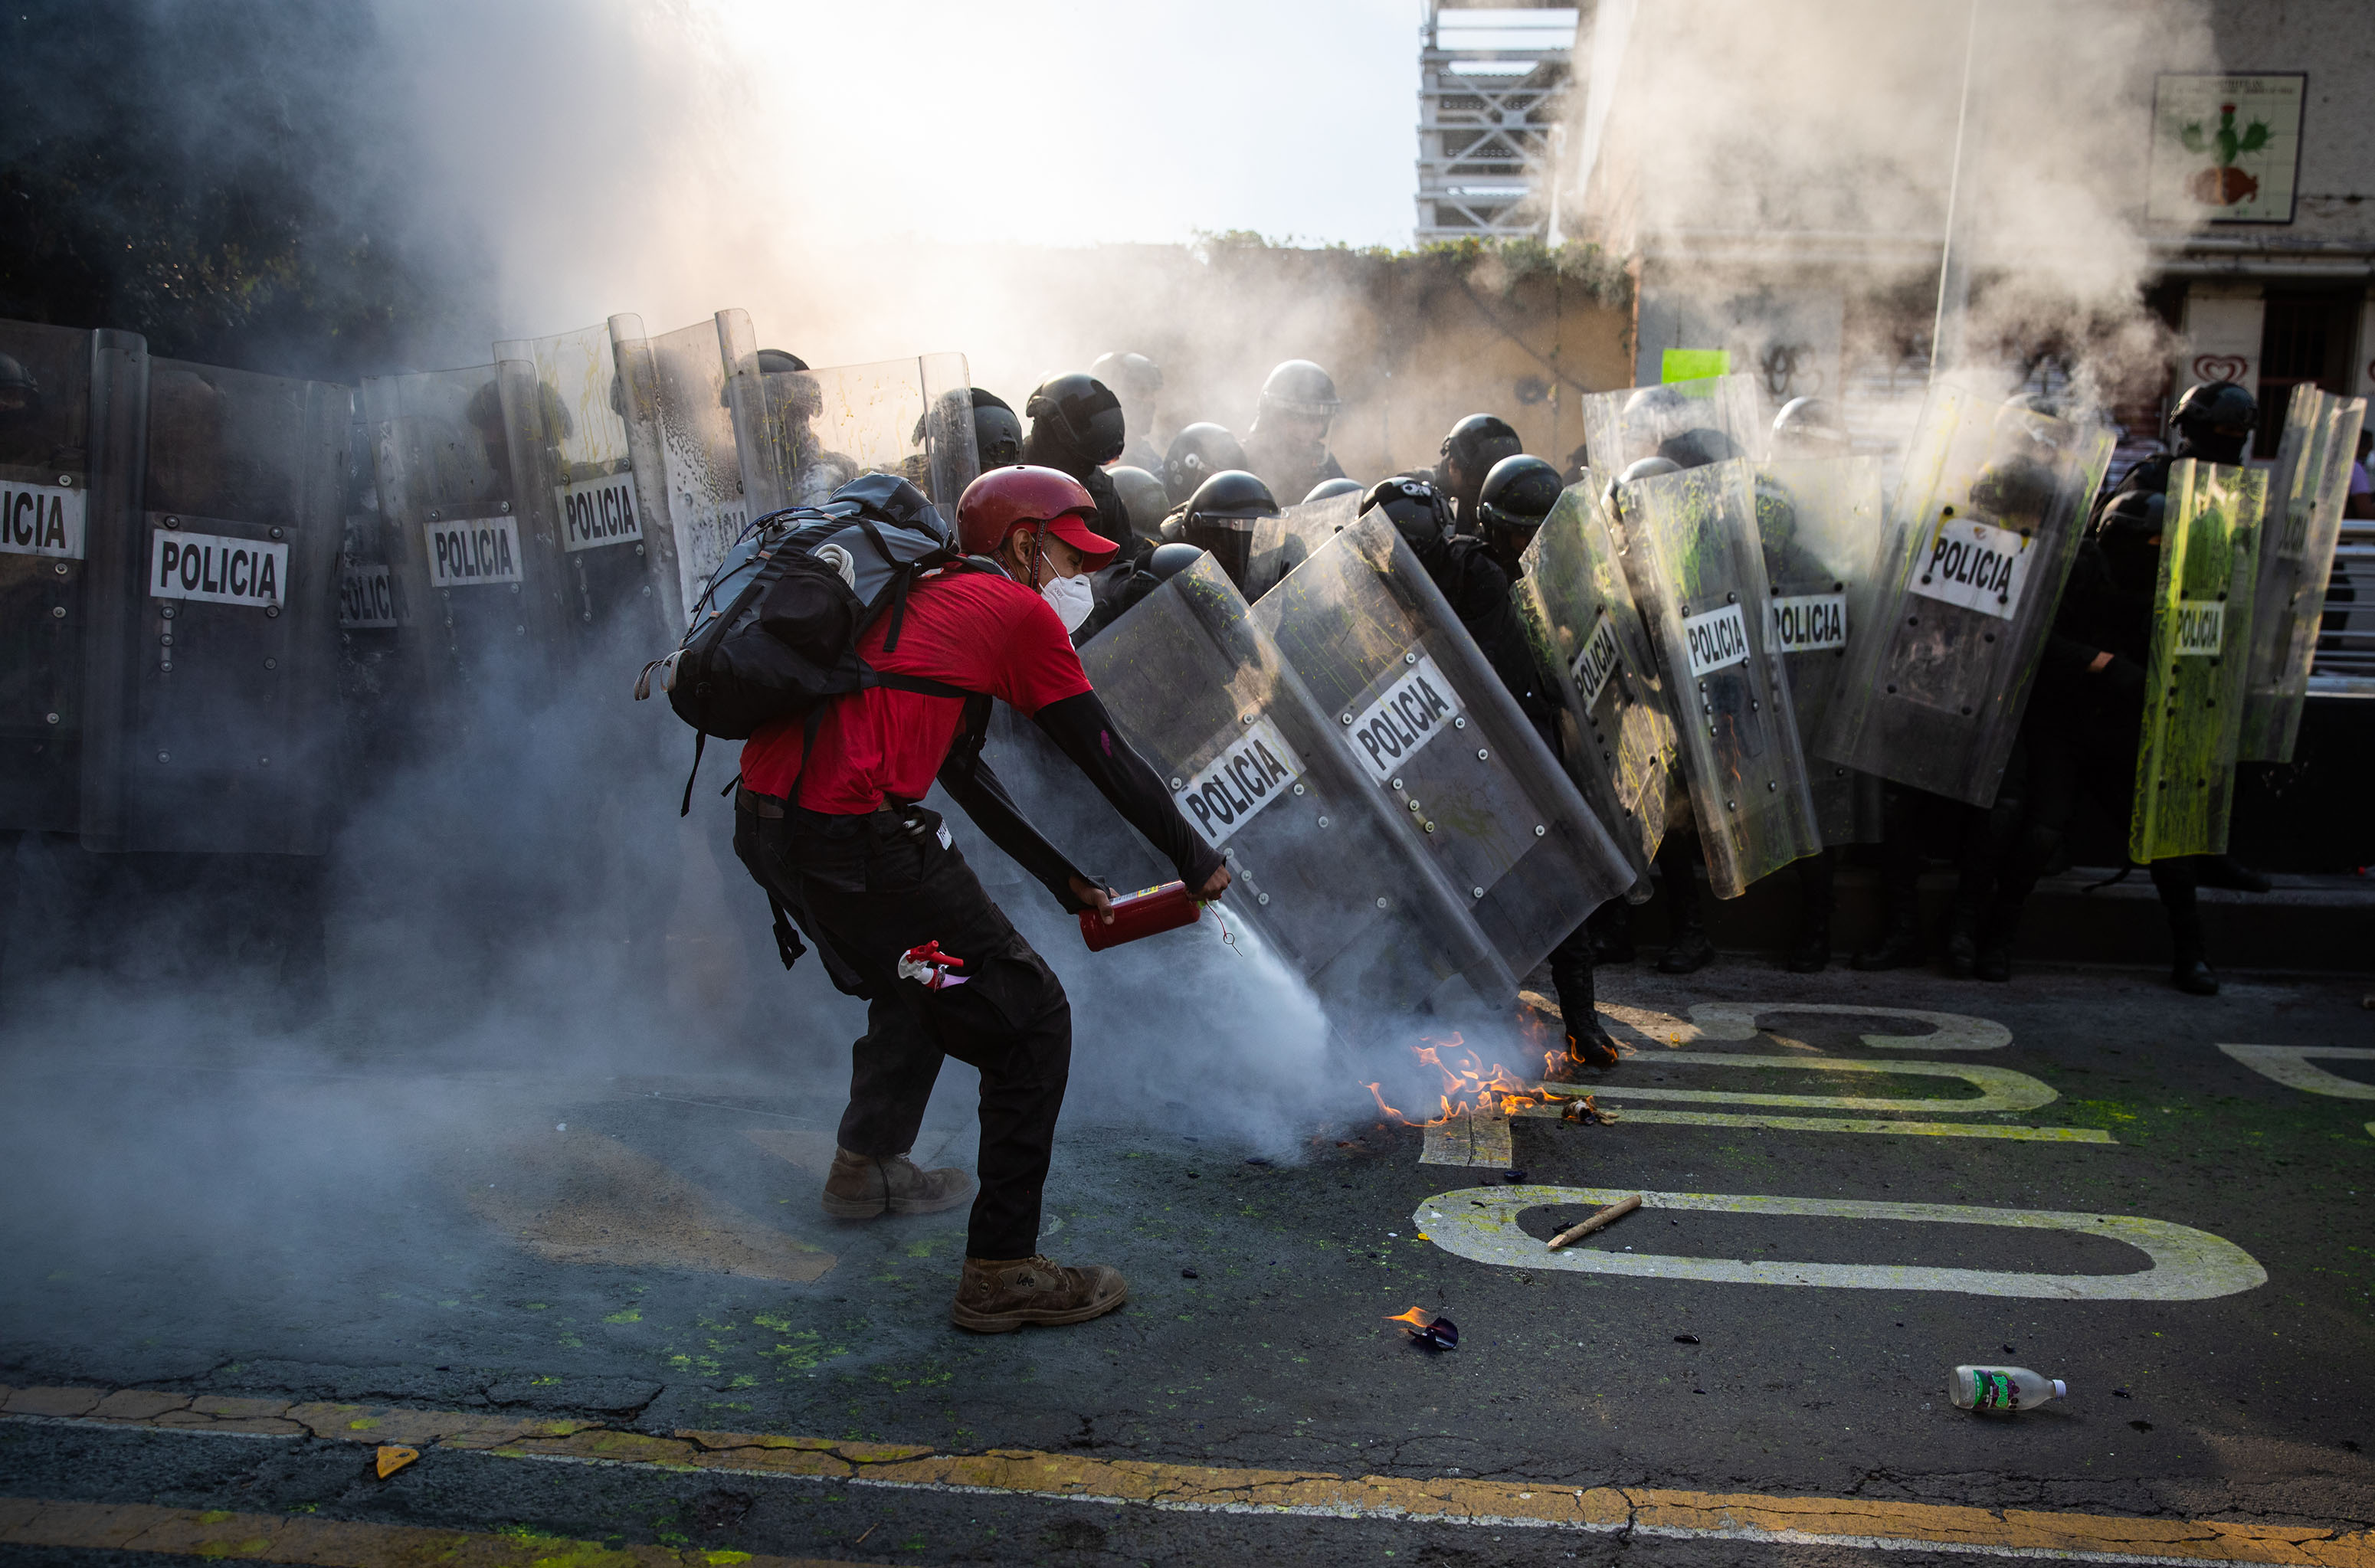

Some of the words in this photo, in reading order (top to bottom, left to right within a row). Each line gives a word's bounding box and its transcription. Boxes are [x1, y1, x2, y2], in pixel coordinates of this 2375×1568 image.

[564, 484, 637, 542] POLICIA
[160, 542, 277, 599] POLICIA
[434, 525, 514, 579] POLICIA
[1928, 537, 2014, 595] POLICIA
[1688, 615, 1746, 667] POLICIA
[1357, 675, 1449, 771] POLICIA
[1186, 739, 1289, 838] POLICIA
[1017, 1272, 1034, 1288] Lee
